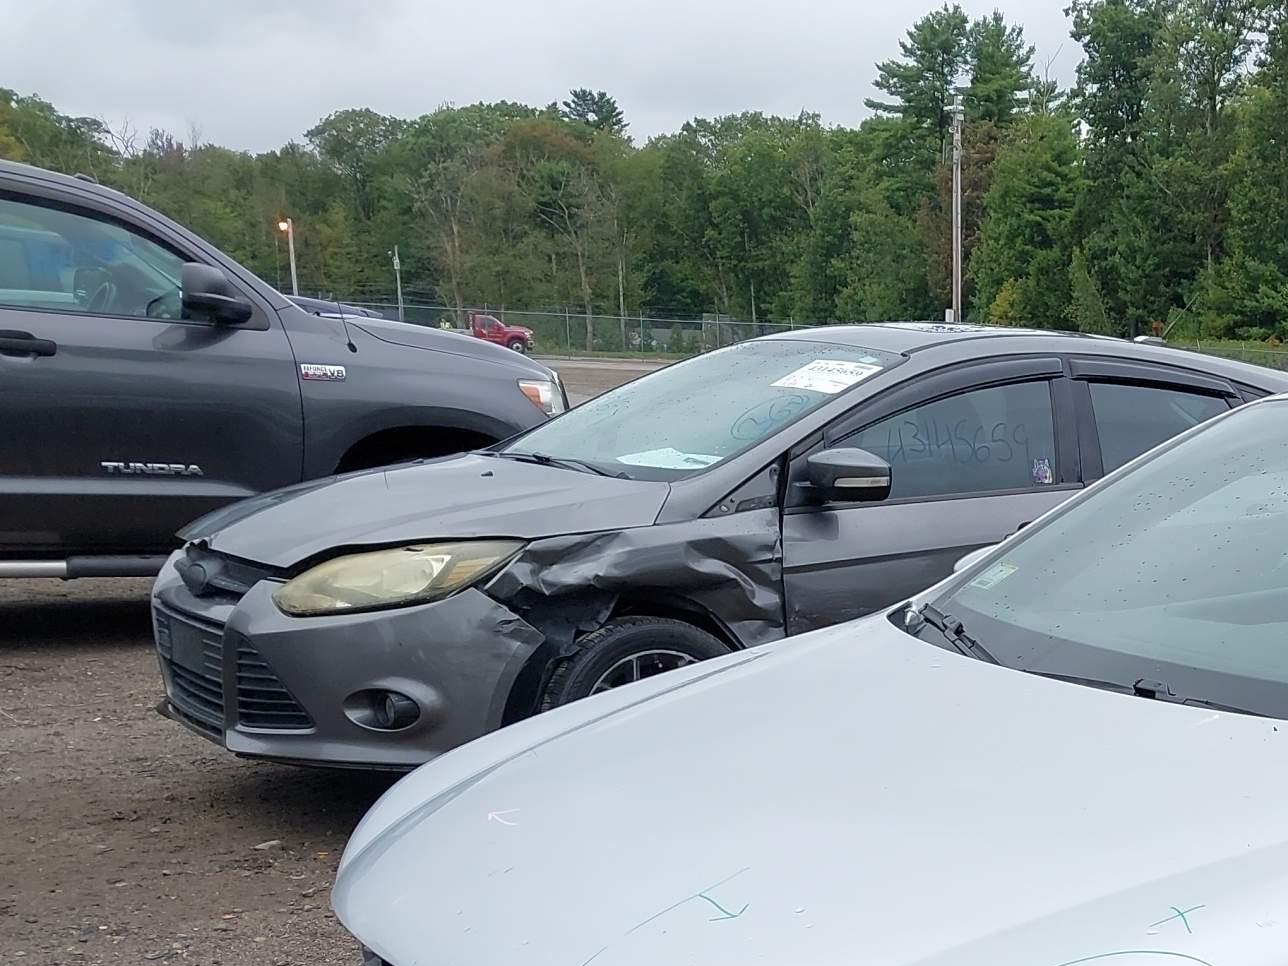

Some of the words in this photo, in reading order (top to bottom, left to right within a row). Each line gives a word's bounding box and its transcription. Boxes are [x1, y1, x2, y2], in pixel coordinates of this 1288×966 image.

[328, 367, 345, 378] V8
[887, 418, 1030, 465] 43145659
[100, 461, 204, 476] TUNDRA
